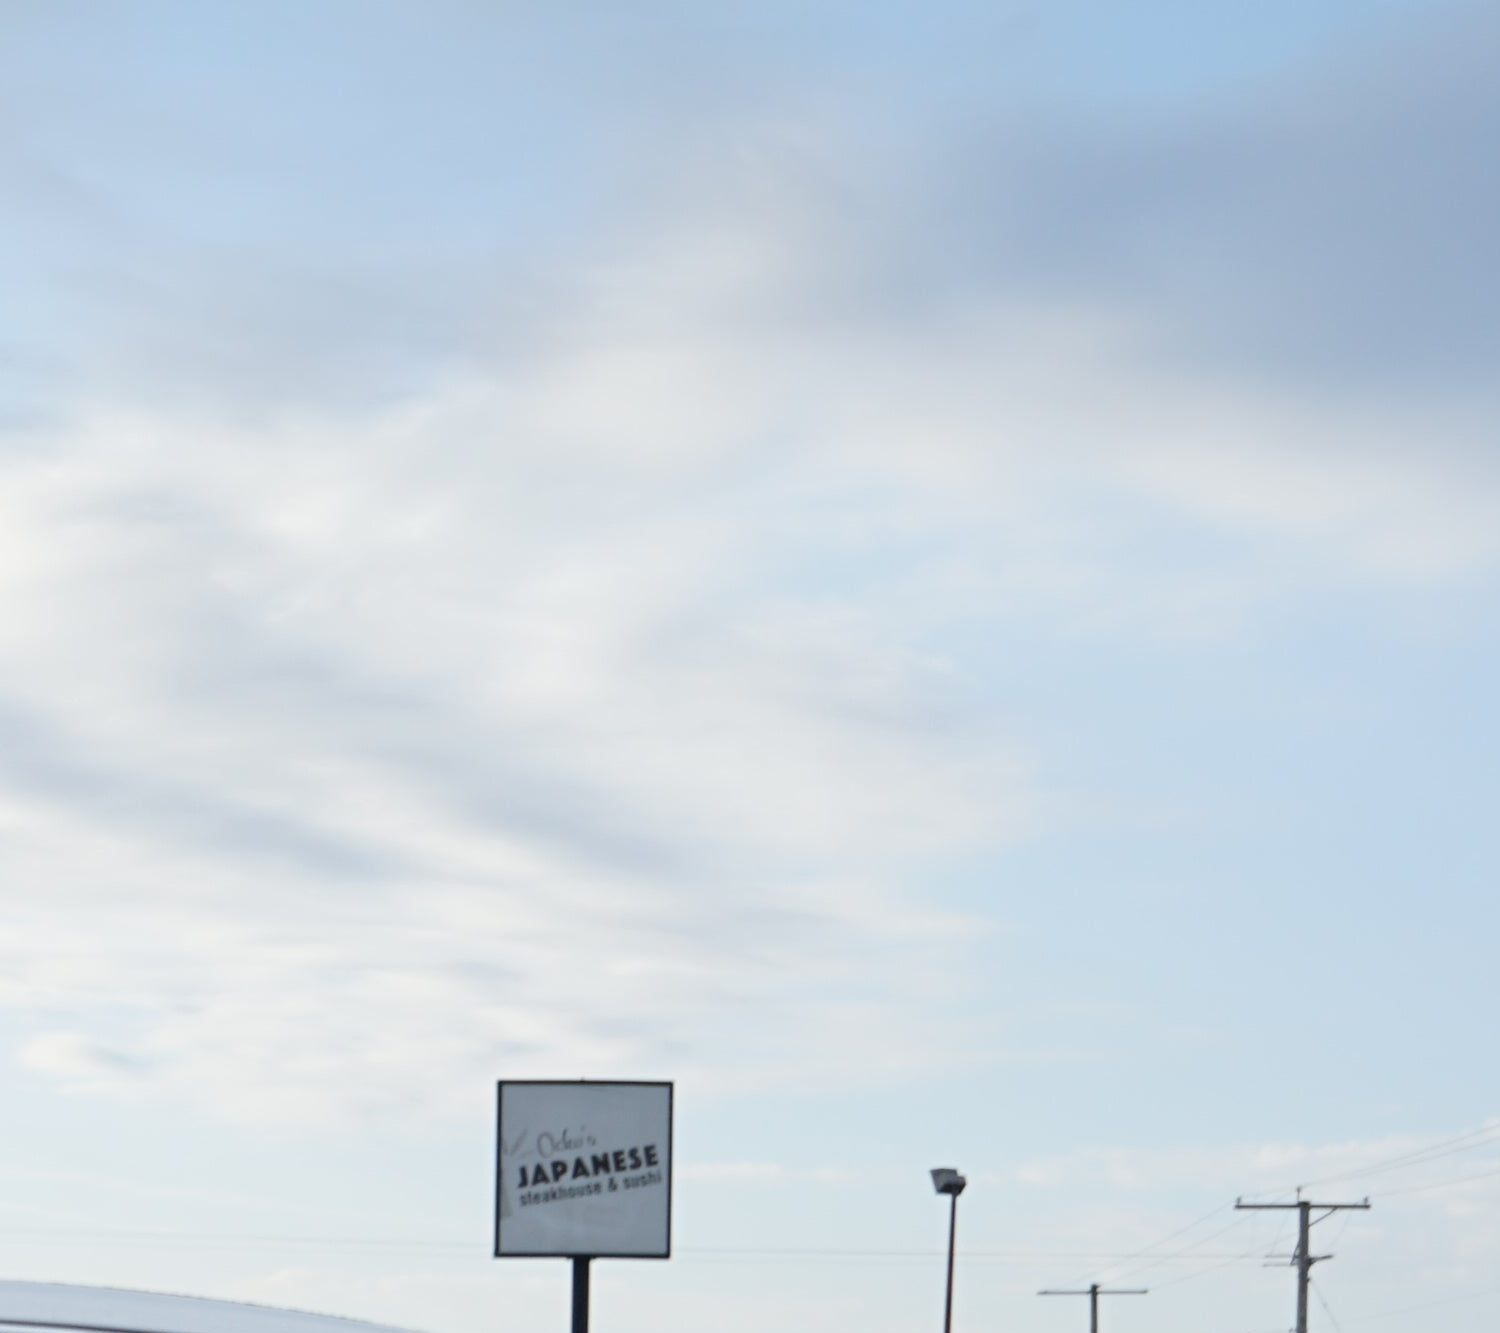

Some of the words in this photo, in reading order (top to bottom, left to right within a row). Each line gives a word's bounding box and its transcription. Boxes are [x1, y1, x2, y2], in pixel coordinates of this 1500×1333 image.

[518, 1145, 659, 1189] JAPANESE
[520, 1181, 602, 1207] steakhouse
[608, 1177, 618, 1193] &
[622, 1169, 662, 1190] sushi
